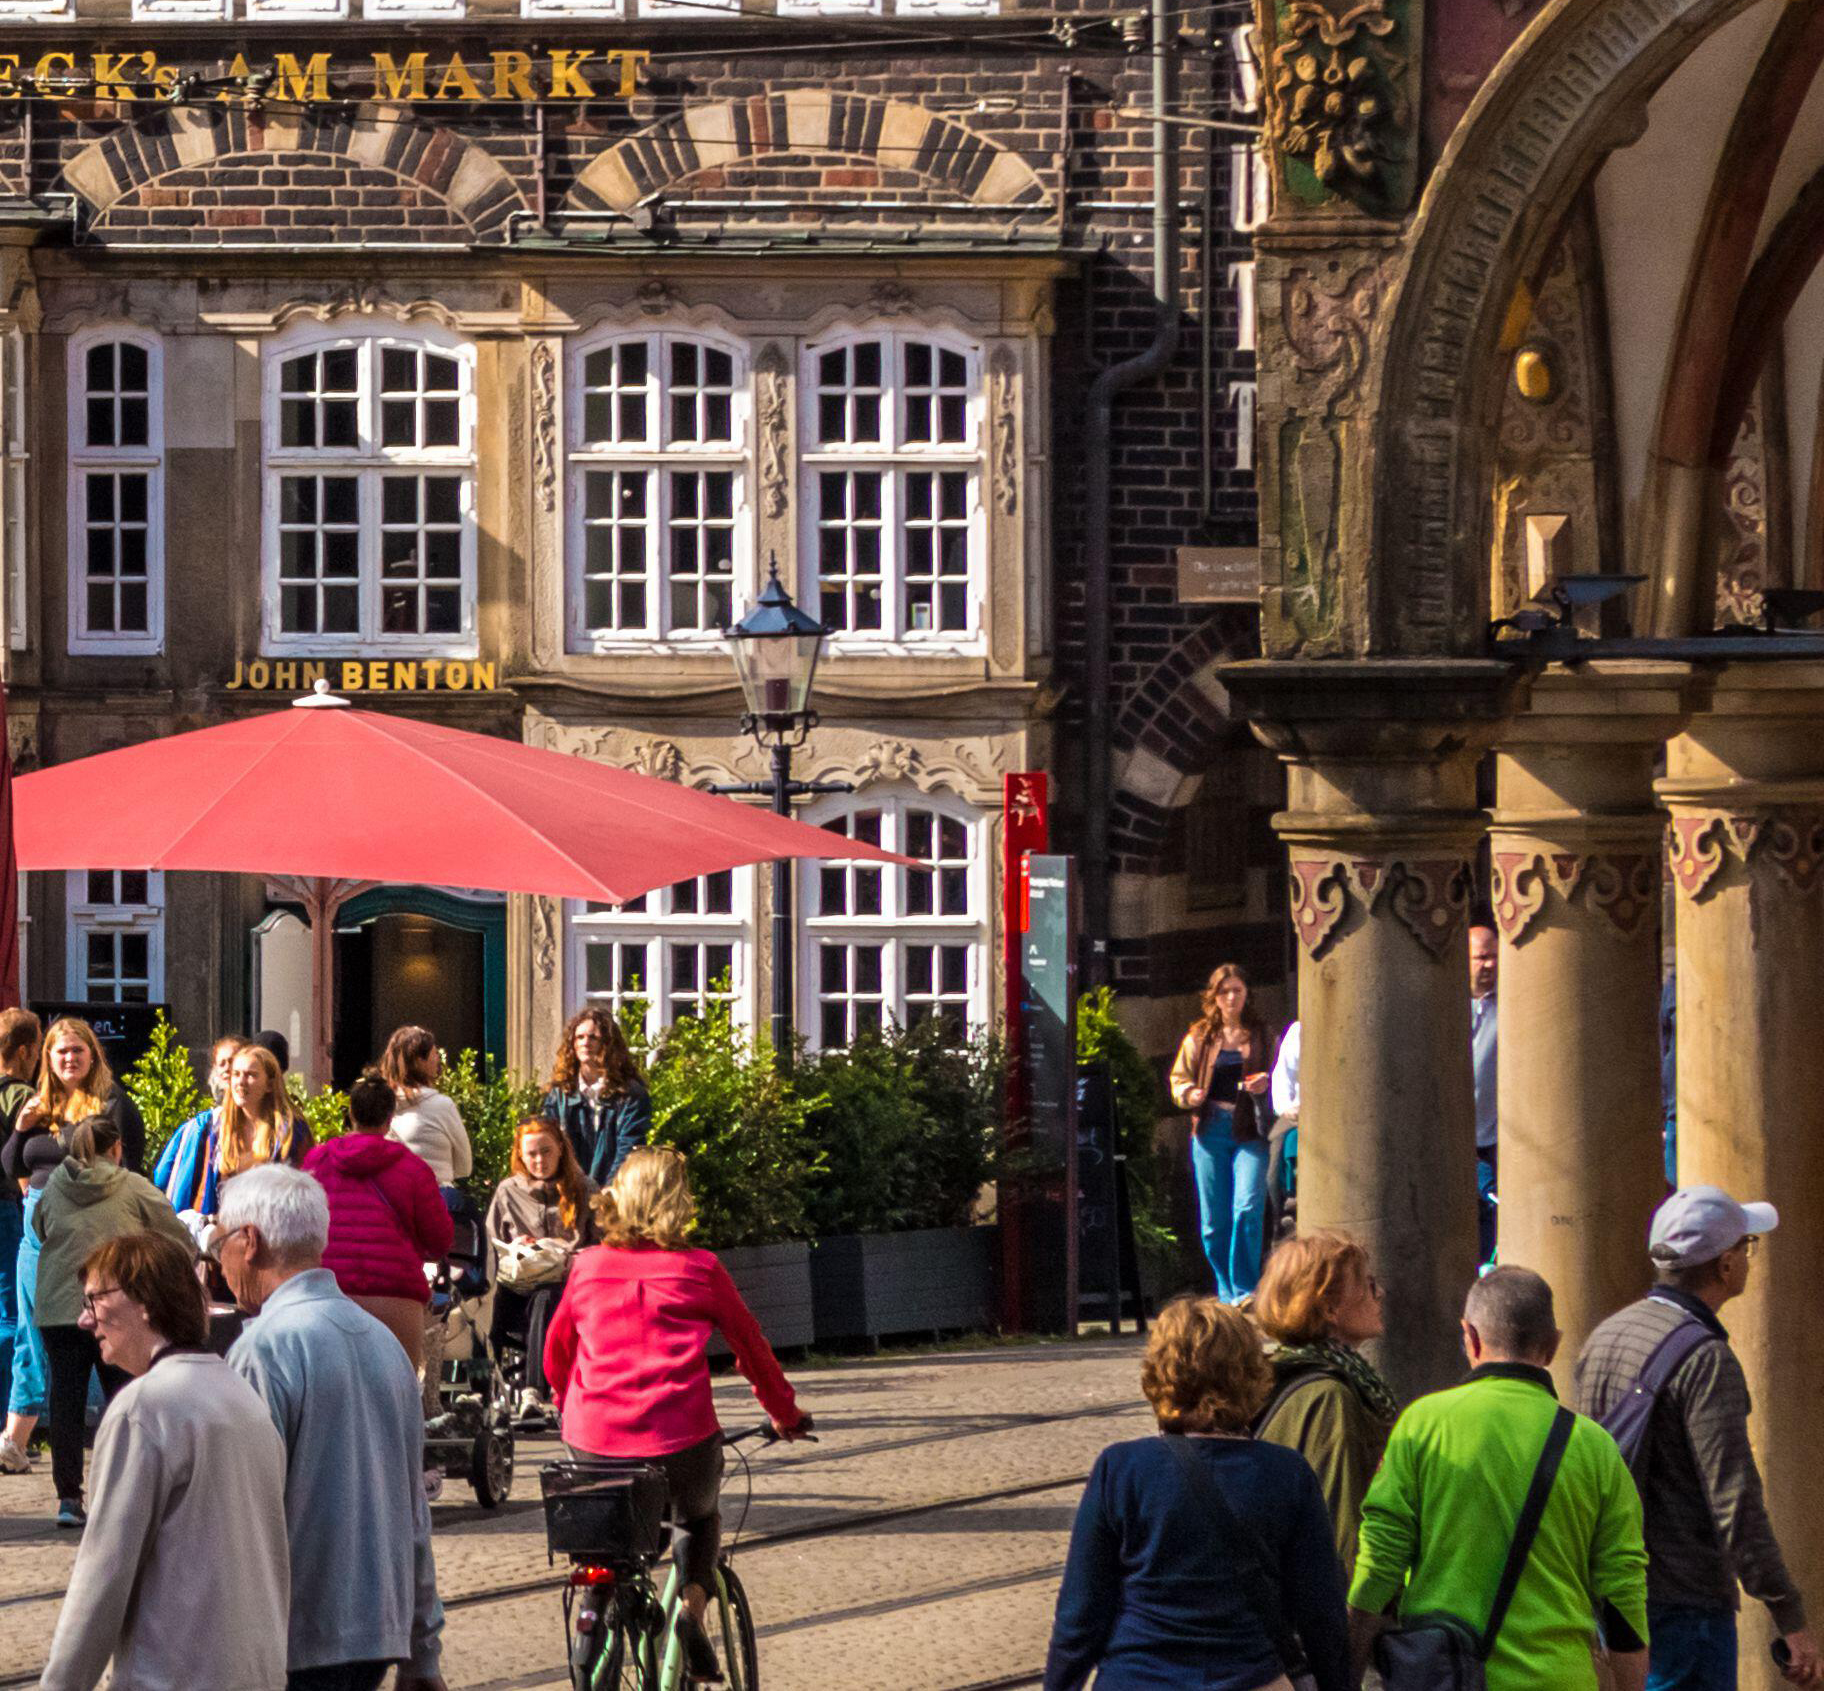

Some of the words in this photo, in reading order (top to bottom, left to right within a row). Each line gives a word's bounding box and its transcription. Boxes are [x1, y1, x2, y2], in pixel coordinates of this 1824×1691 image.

[216, 52, 333, 101] AM
[371, 49, 650, 101] MARKT
[226, 661, 326, 690] JOHN
[342, 661, 495, 690] BENTON
